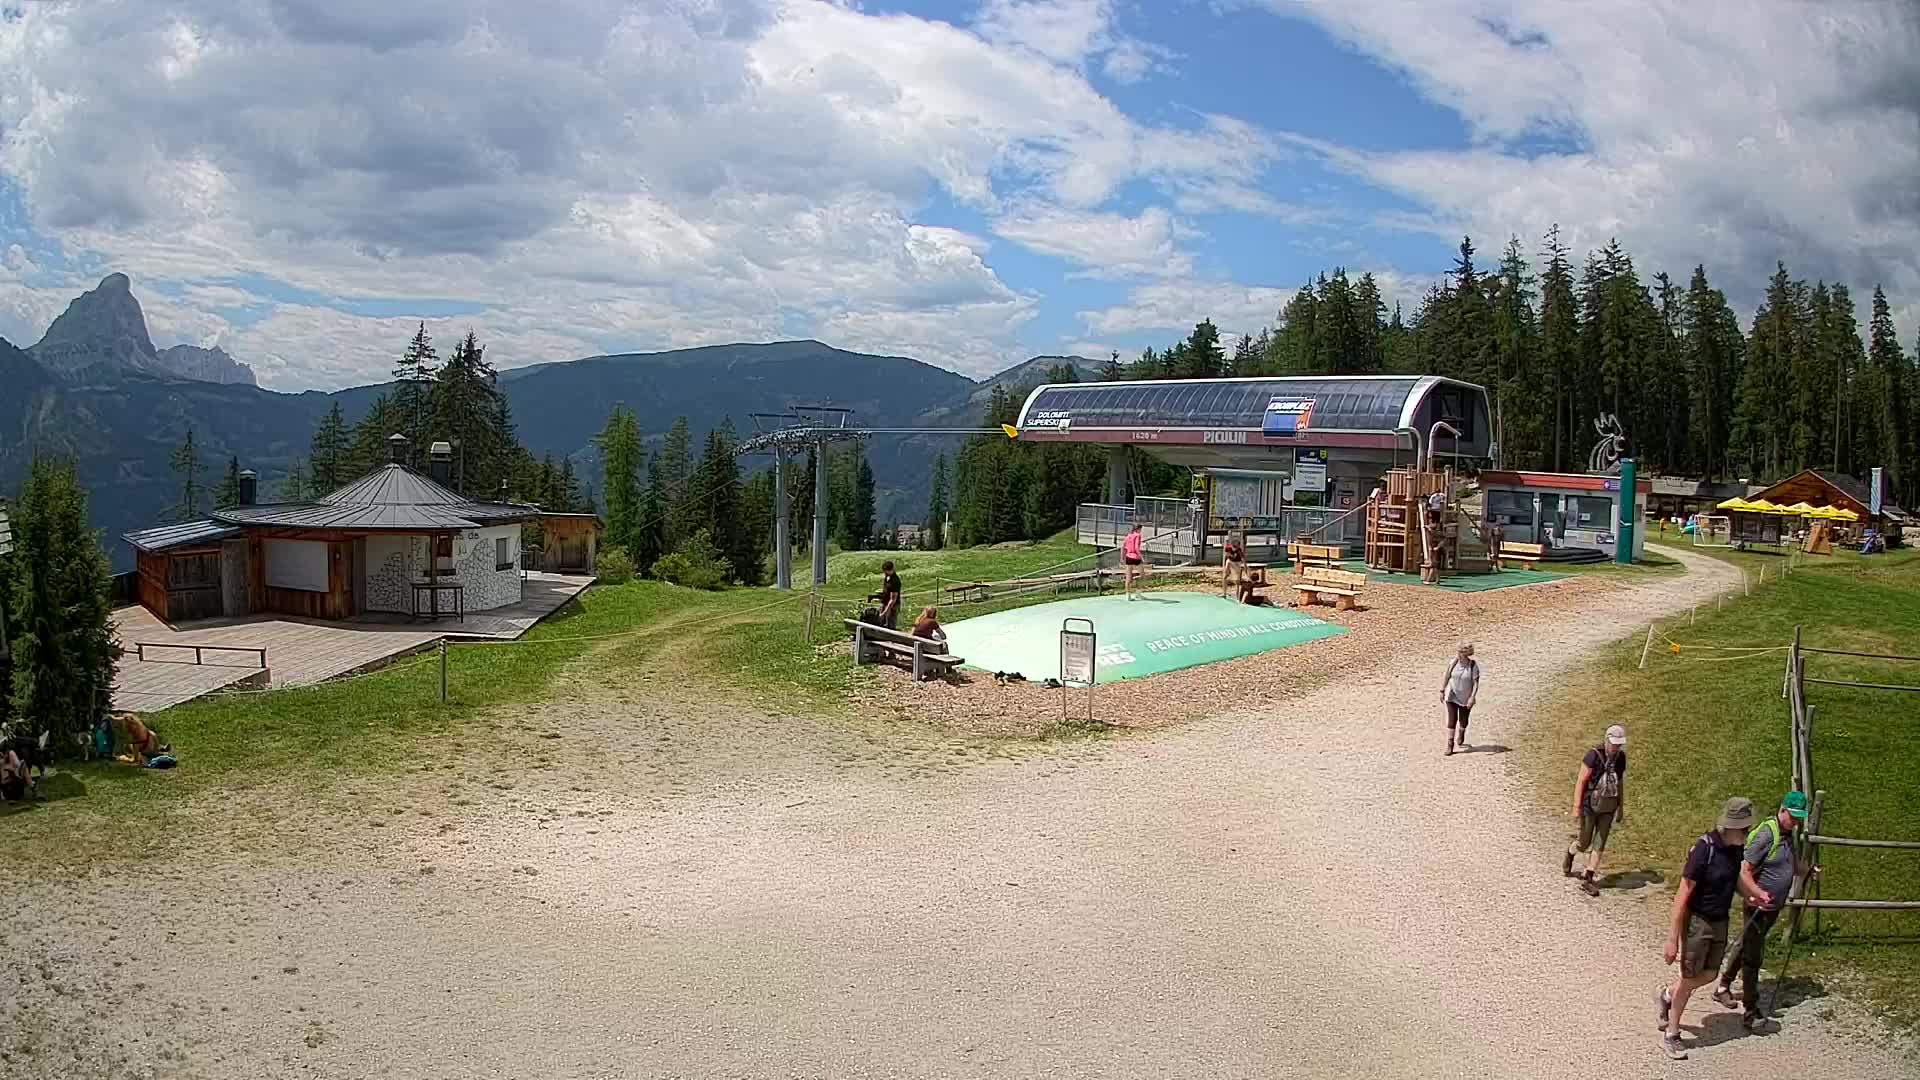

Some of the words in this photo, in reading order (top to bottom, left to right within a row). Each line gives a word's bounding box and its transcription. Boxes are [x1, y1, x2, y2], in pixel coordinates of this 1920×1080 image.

[1037, 410, 1070, 419] DOLOMITI
[1026, 418, 1060, 426] SUPERSKI
[1131, 431, 1150, 440] 1620
[1203, 431, 1248, 444] PICULIN
[1146, 635, 1190, 653] PEACE
[1189, 633, 1206, 645] OF
[1206, 628, 1237, 641] MIND
[1235, 627, 1252, 638] IN
[1249, 623, 1271, 636] ALL
